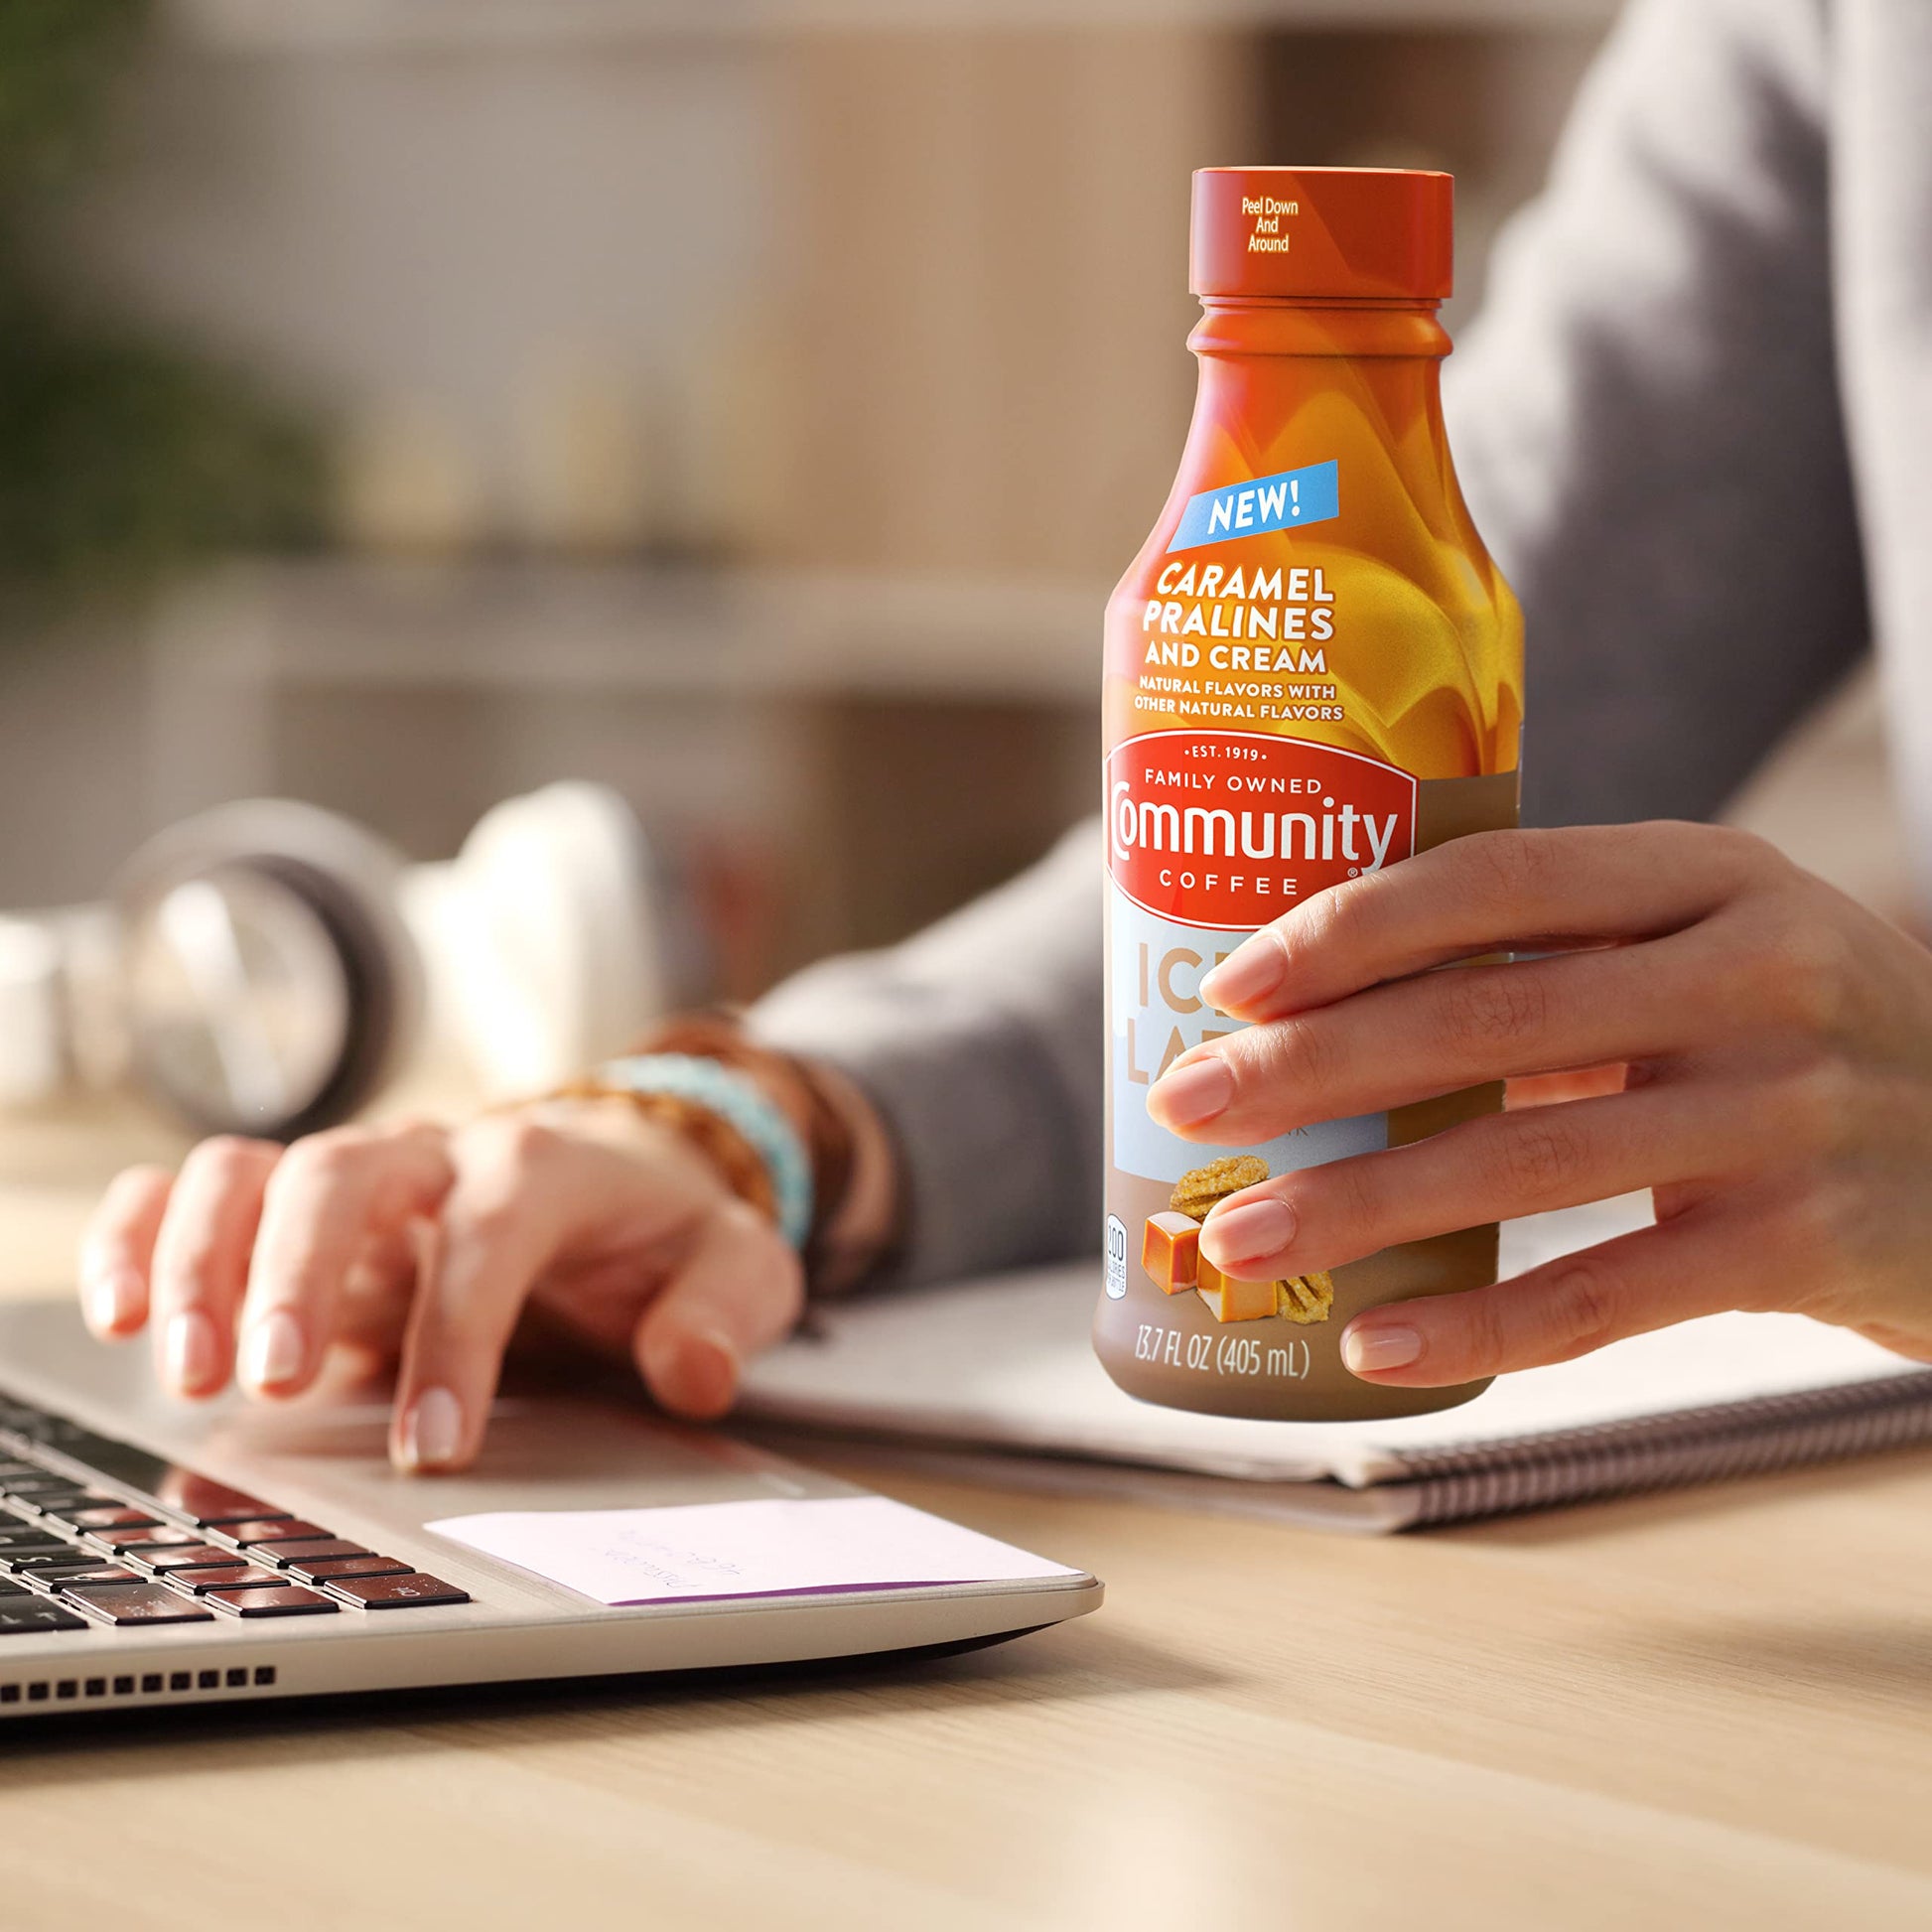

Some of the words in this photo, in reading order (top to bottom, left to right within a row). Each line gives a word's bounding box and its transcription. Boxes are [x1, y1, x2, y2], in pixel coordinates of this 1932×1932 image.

[1242, 197, 1263, 214] Peel
[1265, 198, 1299, 214] Down
[1255, 216, 1279, 233] And
[1248, 234, 1289, 252] Around
[1207, 480, 1301, 534] NEW!
[1157, 562, 1333, 602] CARAMEL
[1143, 600, 1333, 640] PRALINES
[1145, 640, 1200, 667] AND
[1209, 645, 1326, 672] CREAM
[1139, 675, 1200, 694] NATURAL
[1204, 681, 1283, 698] FLAVORS
[1288, 684, 1335, 699] WITH
[1134, 696, 1175, 714] OTHER
[1179, 701, 1255, 718] NATURAL
[1260, 705, 1343, 721] FLAVORS
[1225, 747, 1259, 761] 1919
[1145, 768, 1216, 790] FAMILY
[1227, 776, 1321, 794] OWNED
[1111, 781, 1398, 875] Community
[1159, 869, 1298, 896] COFFEE
[1135, 1324, 1163, 1362] 13.7
[1164, 1330, 1181, 1366] FL
[1186, 1333, 1212, 1370] OZ
[1216, 1335, 1261, 1375] (405
[1267, 1339, 1310, 1380] mL)
